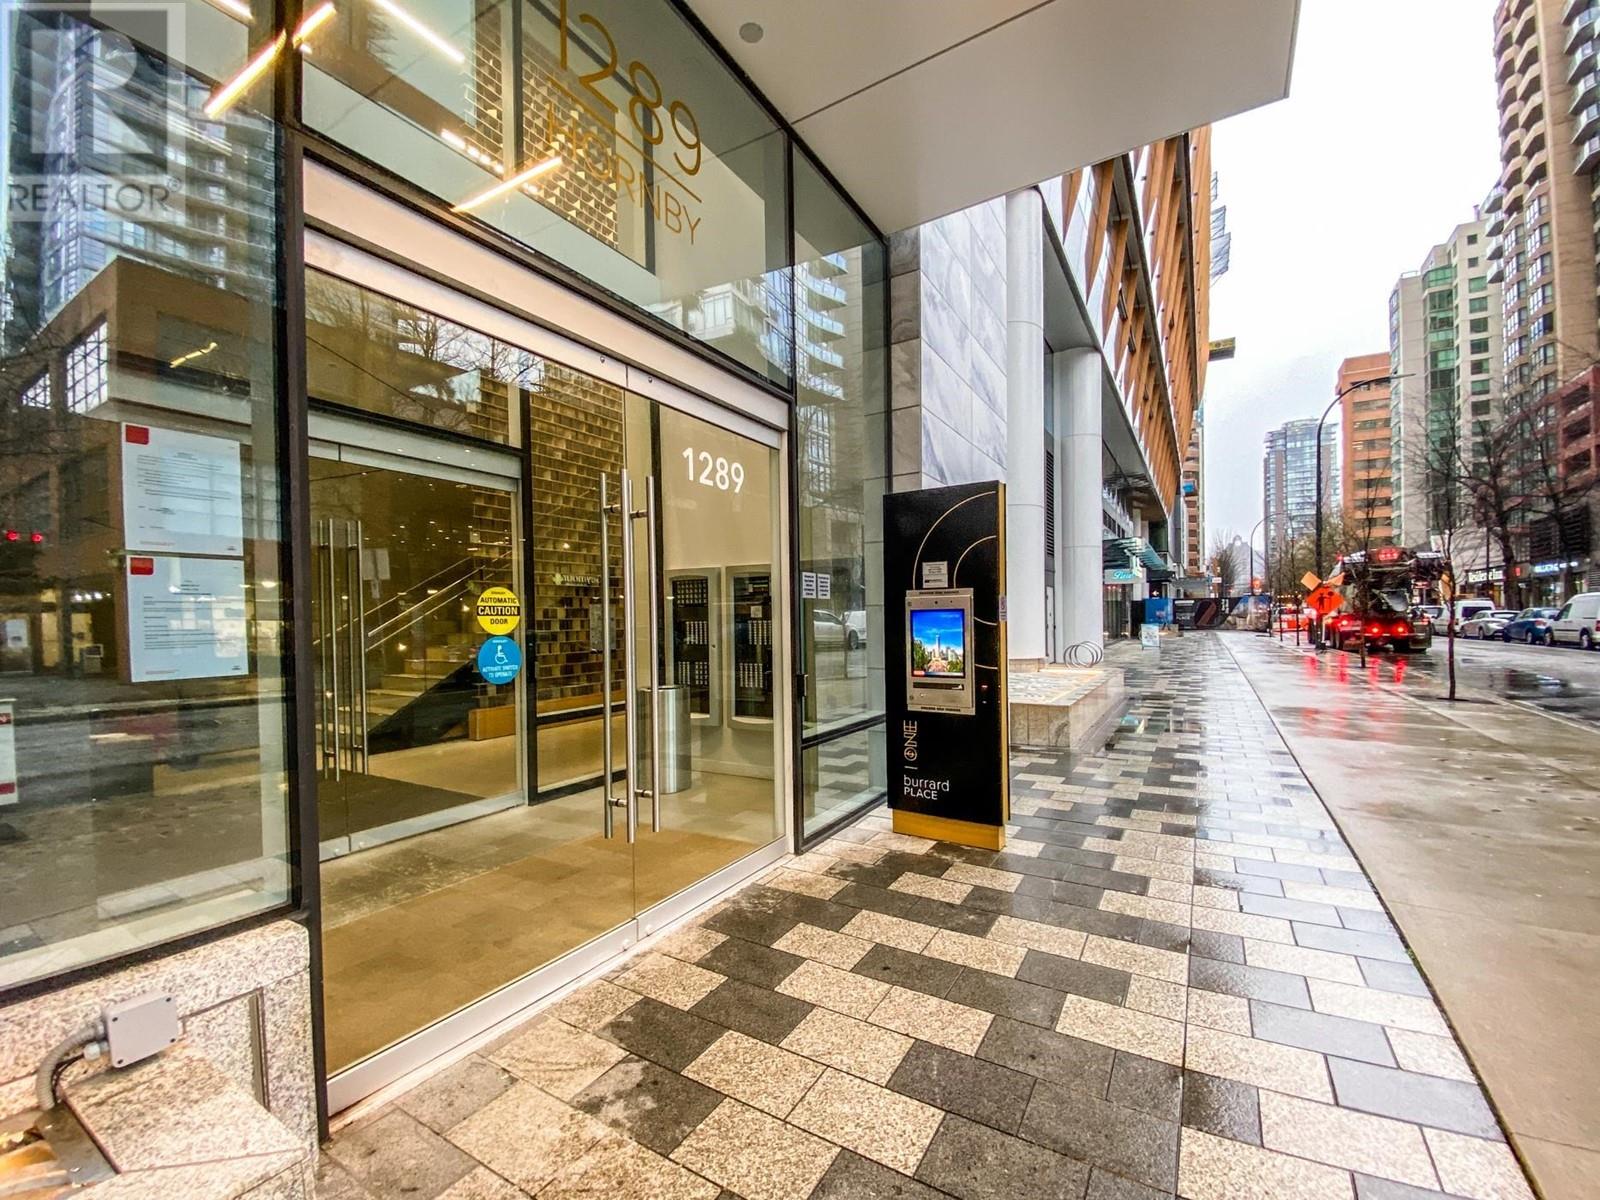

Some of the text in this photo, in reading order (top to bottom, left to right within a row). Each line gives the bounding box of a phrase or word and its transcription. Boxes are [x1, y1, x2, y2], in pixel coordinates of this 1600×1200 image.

[558, 0, 702, 176] 1289
[546, 101, 702, 245] HORNBY
[682, 447, 745, 494] 1289
[478, 606, 518, 616] CAUTION
[903, 720, 918, 762] ONE
[903, 774, 950, 792] burrard
[903, 786, 939, 800] PLACE
